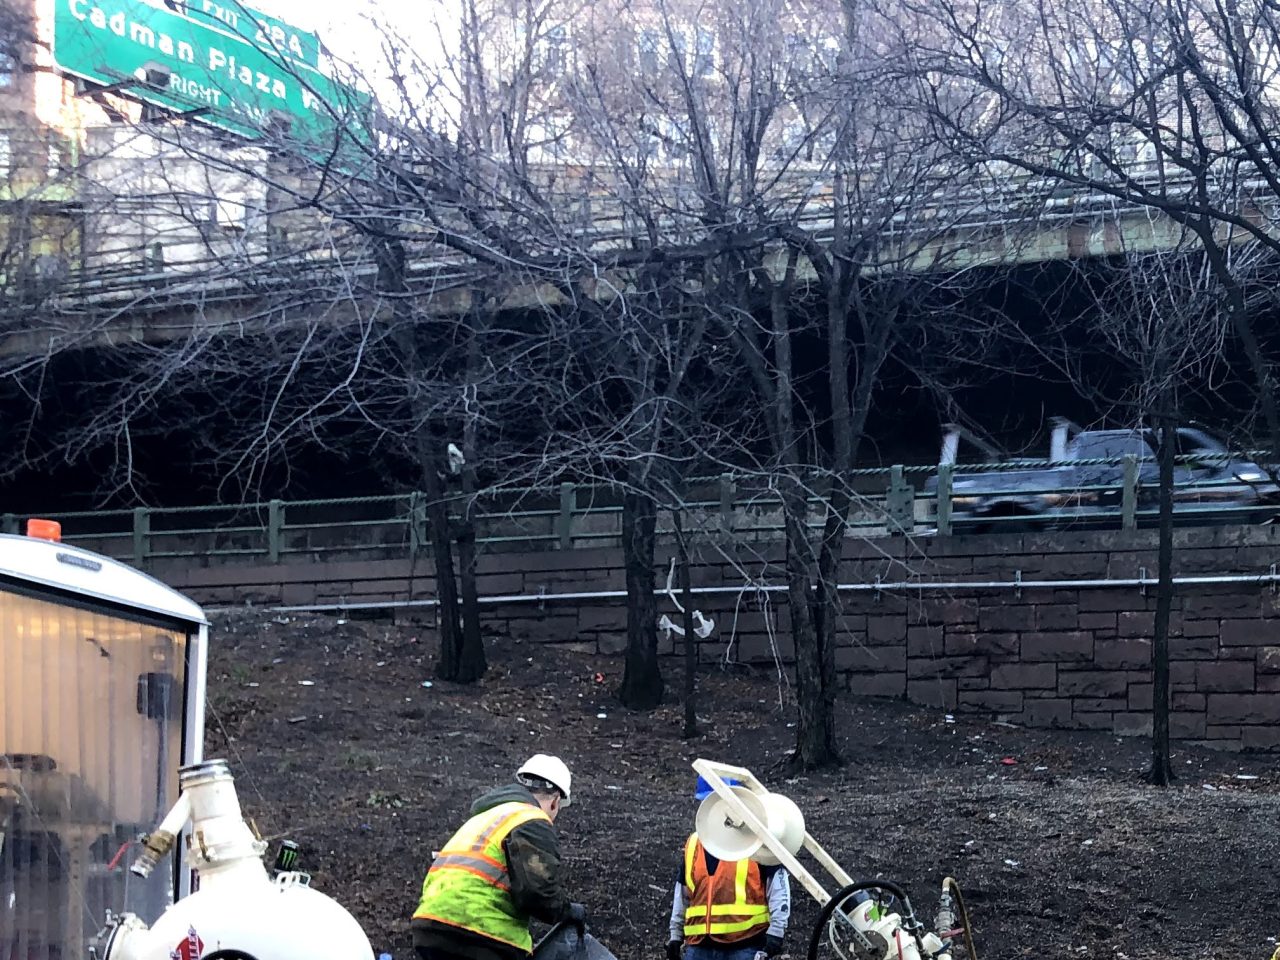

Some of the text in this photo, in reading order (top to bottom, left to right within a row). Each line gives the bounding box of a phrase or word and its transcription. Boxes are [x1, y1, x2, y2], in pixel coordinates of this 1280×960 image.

[202, 1, 241, 28] EXIT
[69, 0, 286, 99] Cadman Plaza
[170, 73, 221, 106] RIGHT
